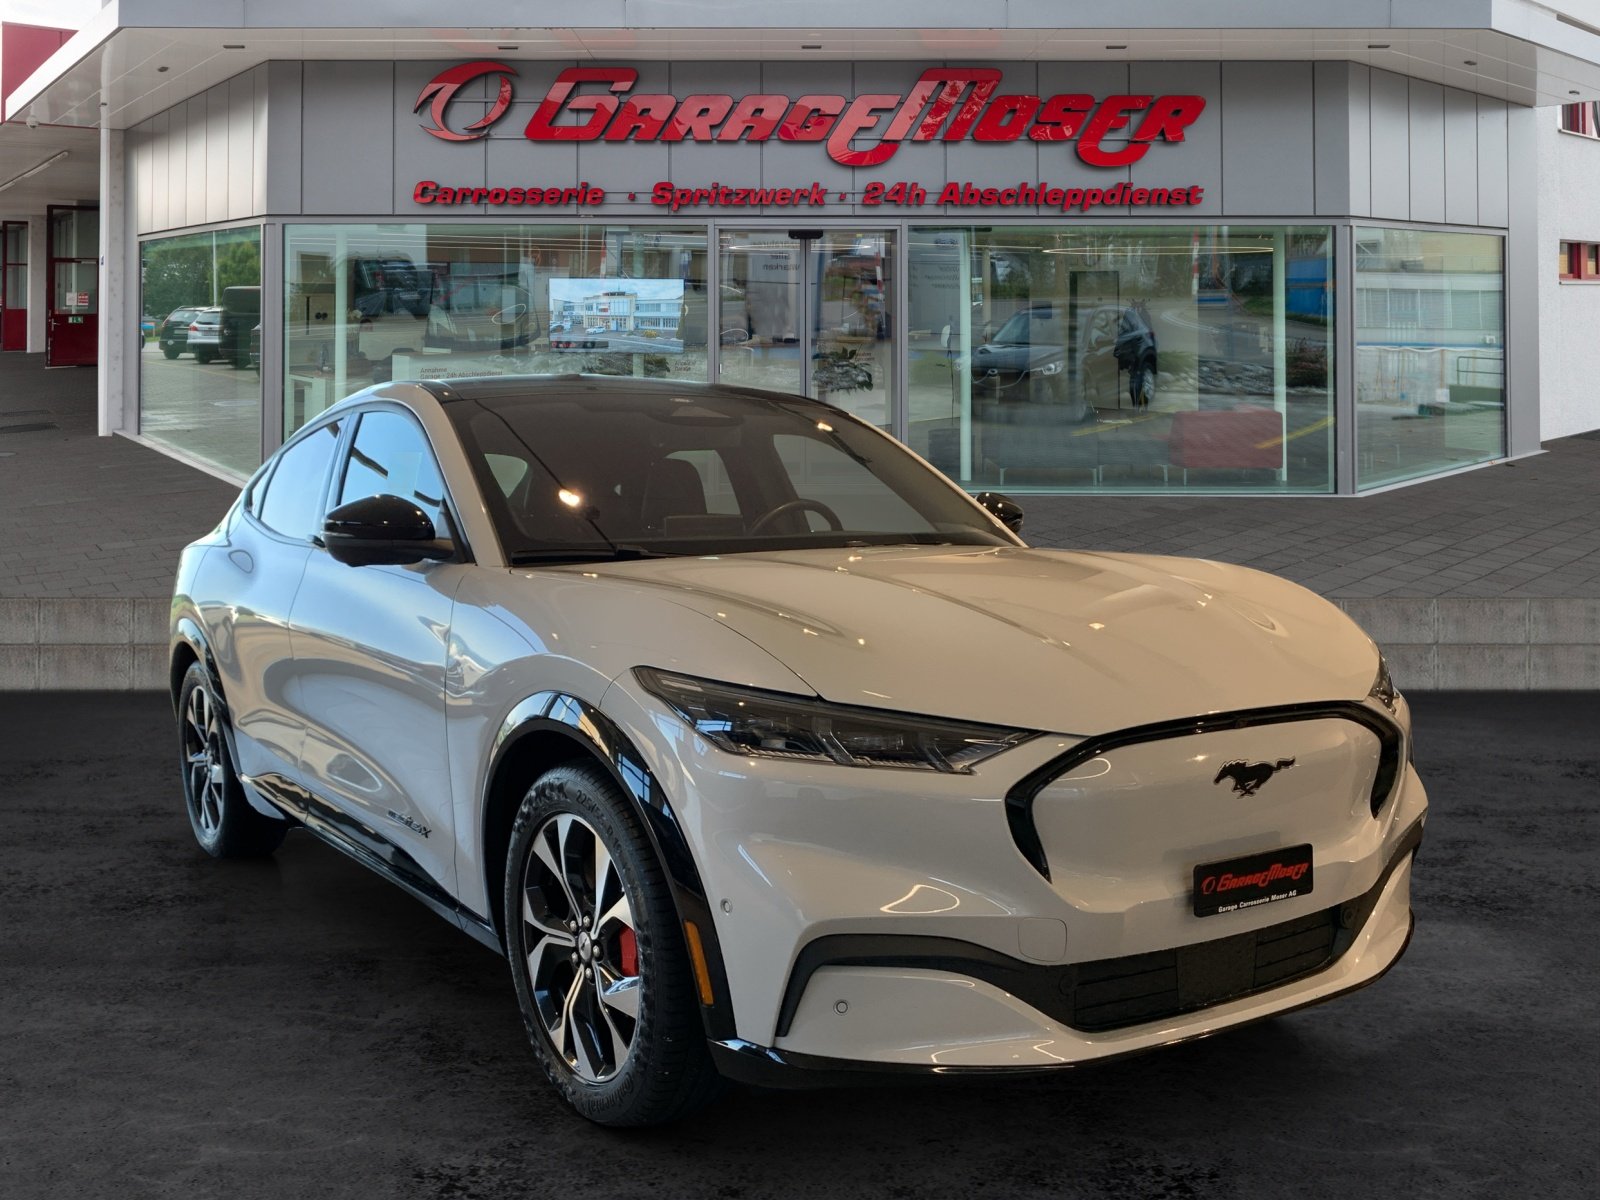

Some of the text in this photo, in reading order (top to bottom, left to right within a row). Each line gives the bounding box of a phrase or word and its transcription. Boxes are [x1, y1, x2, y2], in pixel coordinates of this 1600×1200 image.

[413, 180, 1205, 213] Carrosserie Spritzwerk 24h Abschleppdienst
[1218, 889, 1297, 913] Garage Carrosserie Moser AG
